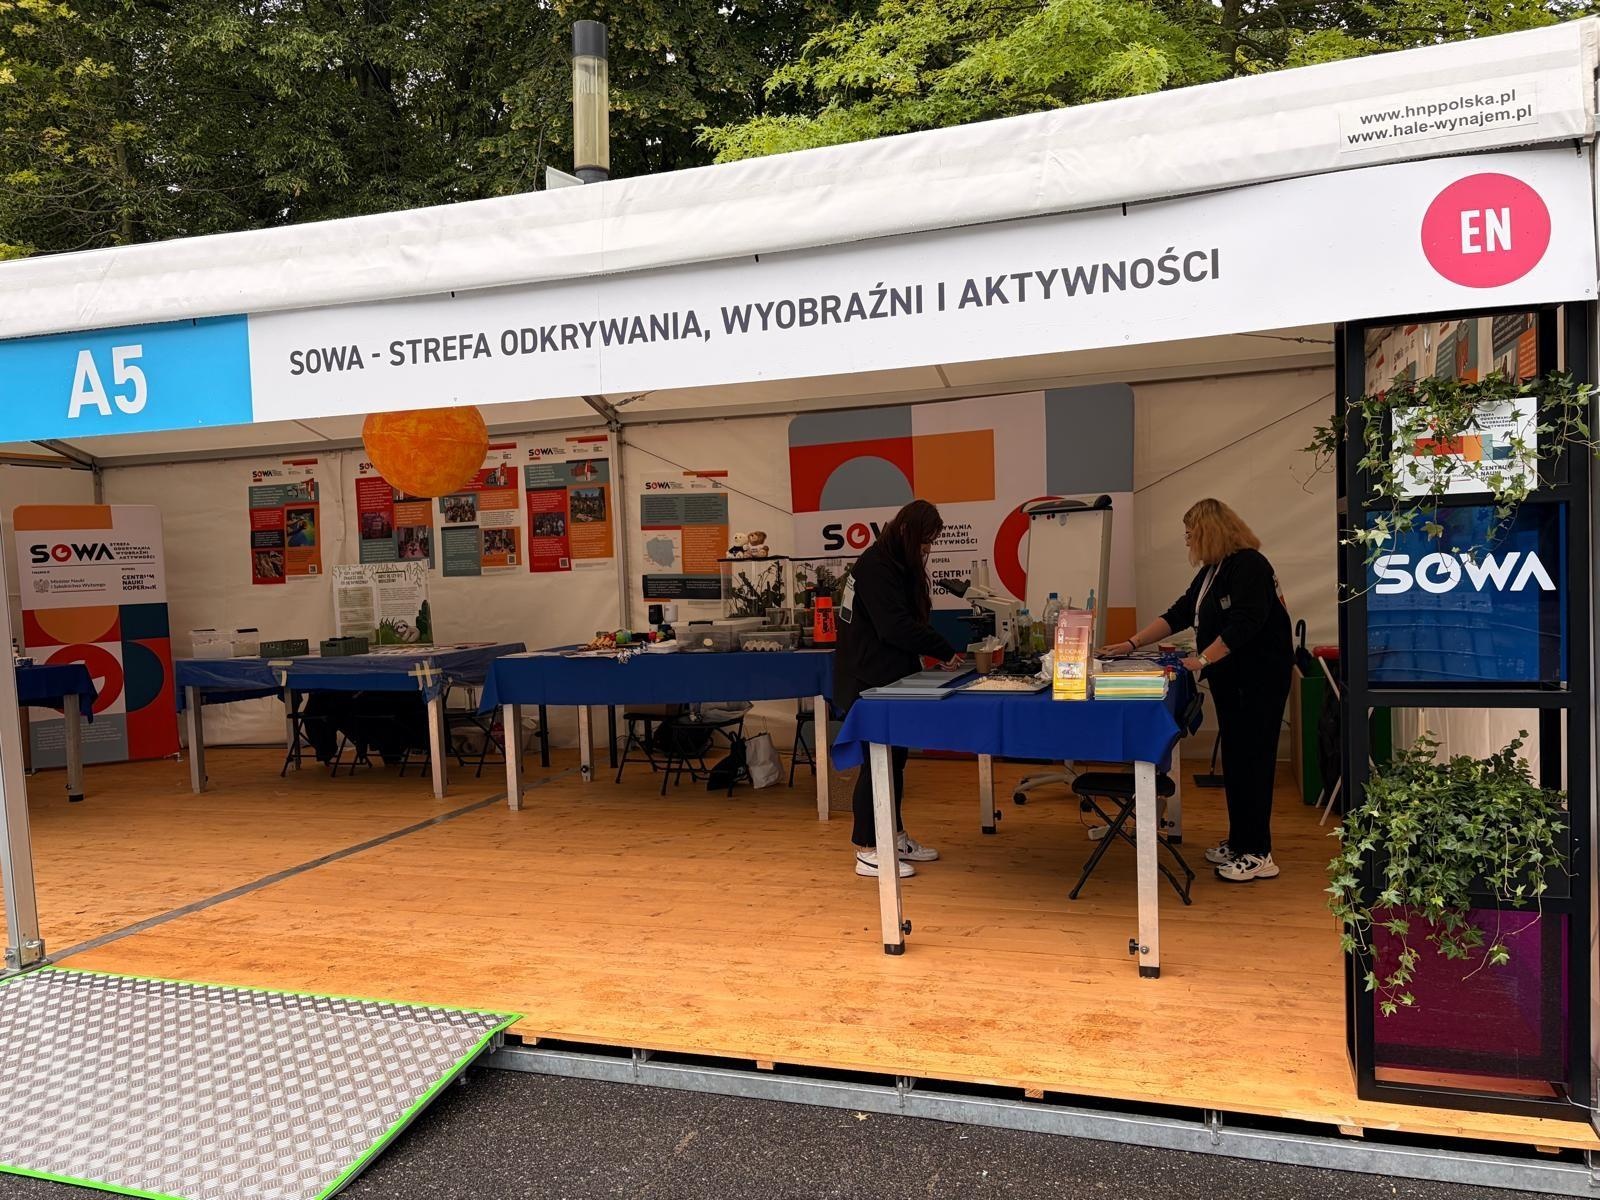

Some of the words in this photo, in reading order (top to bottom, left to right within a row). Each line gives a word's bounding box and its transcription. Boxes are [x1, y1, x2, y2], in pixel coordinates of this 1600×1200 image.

[1347, 104, 1532, 144] www.hale-wynajem.pl
[1360, 89, 1516, 125] www.hnppolska.pl
[1460, 207, 1512, 254] EN
[289, 345, 364, 376] SOWA
[389, 333, 492, 367] STREFA
[501, 309, 711, 357] ODKRYWANIA,
[720, 281, 924, 335] WYOBRAŹNI
[938, 282, 946, 311] I
[957, 247, 1220, 310] AKTYWNOŚCI
[67, 344, 148, 419] A5
[528, 447, 554, 457] SOWA
[252, 470, 273, 478] SOWA
[645, 482, 670, 490] SOWA
[937, 530, 969, 538] OBRAŹNI
[30, 543, 115, 563] SOWA
[1373, 550, 1557, 594] SOWA
